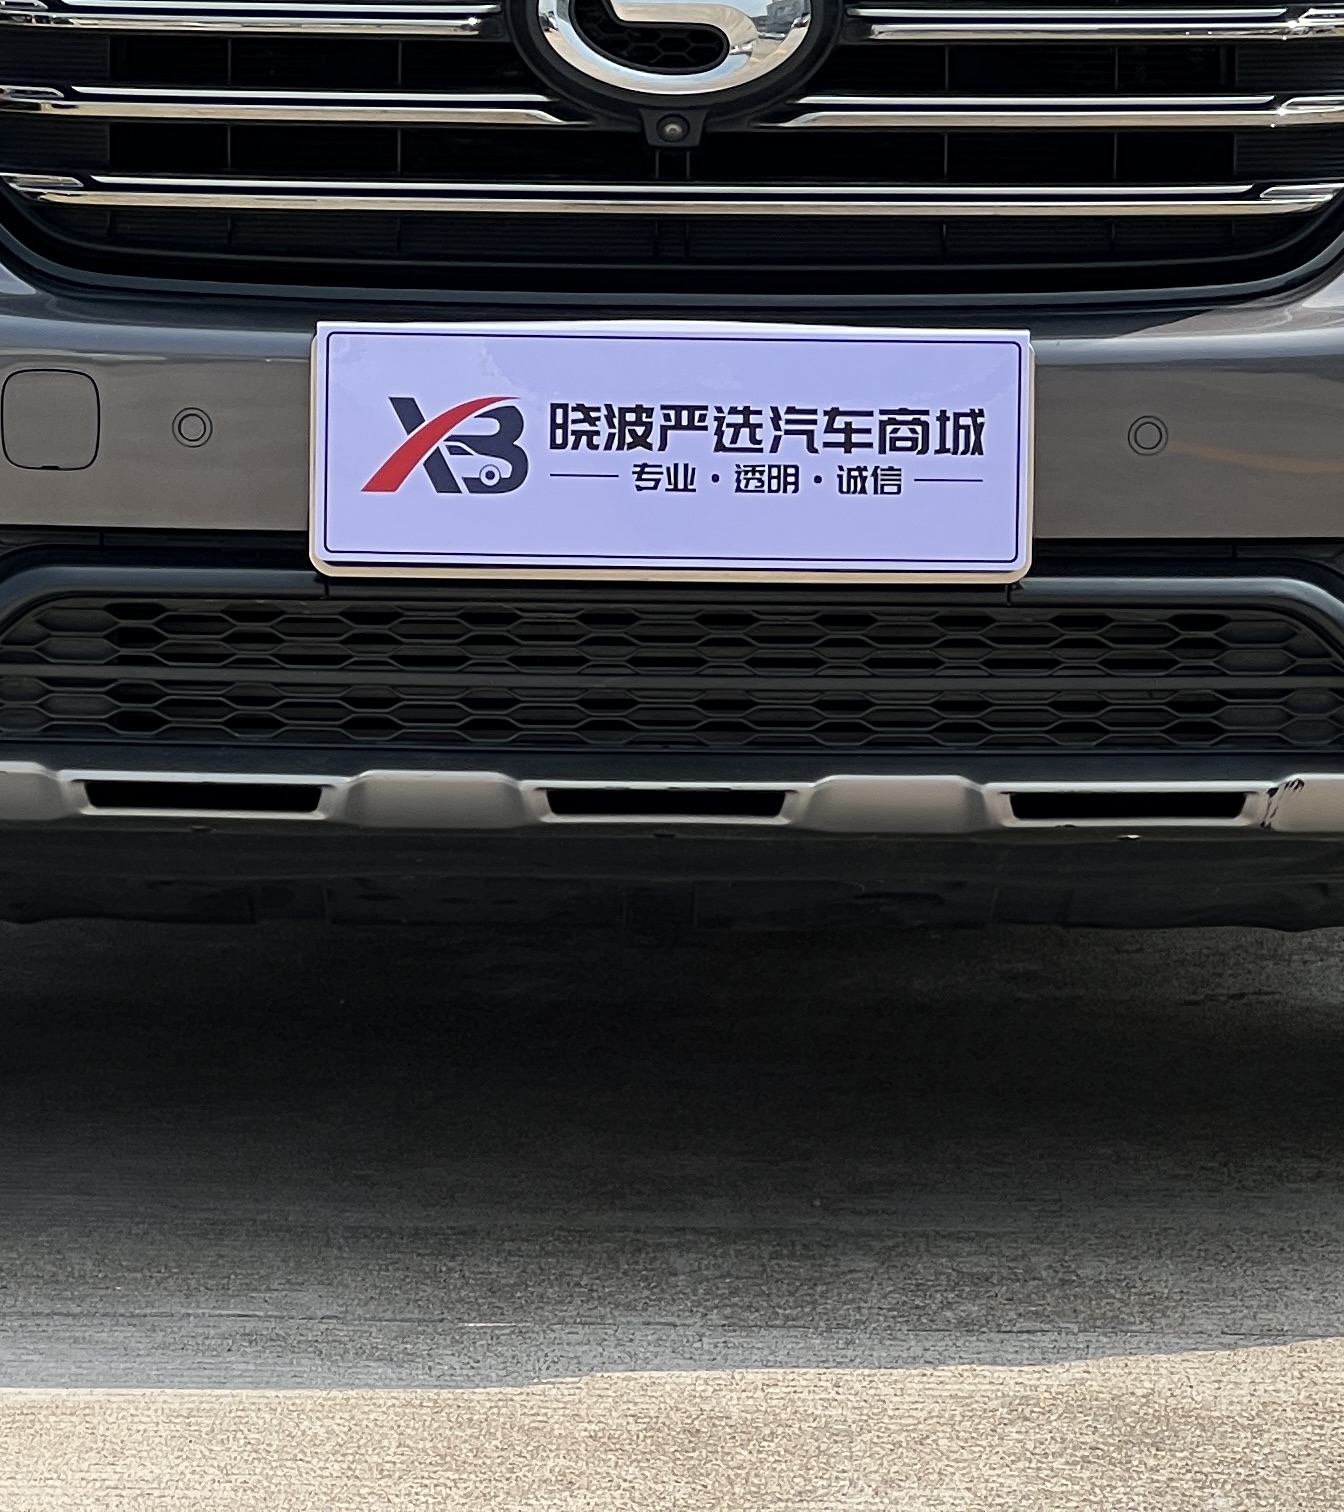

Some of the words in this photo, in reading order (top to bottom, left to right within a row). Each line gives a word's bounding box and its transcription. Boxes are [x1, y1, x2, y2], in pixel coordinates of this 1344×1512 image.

[549, 402, 986, 456] 晓波严选汽车商城
